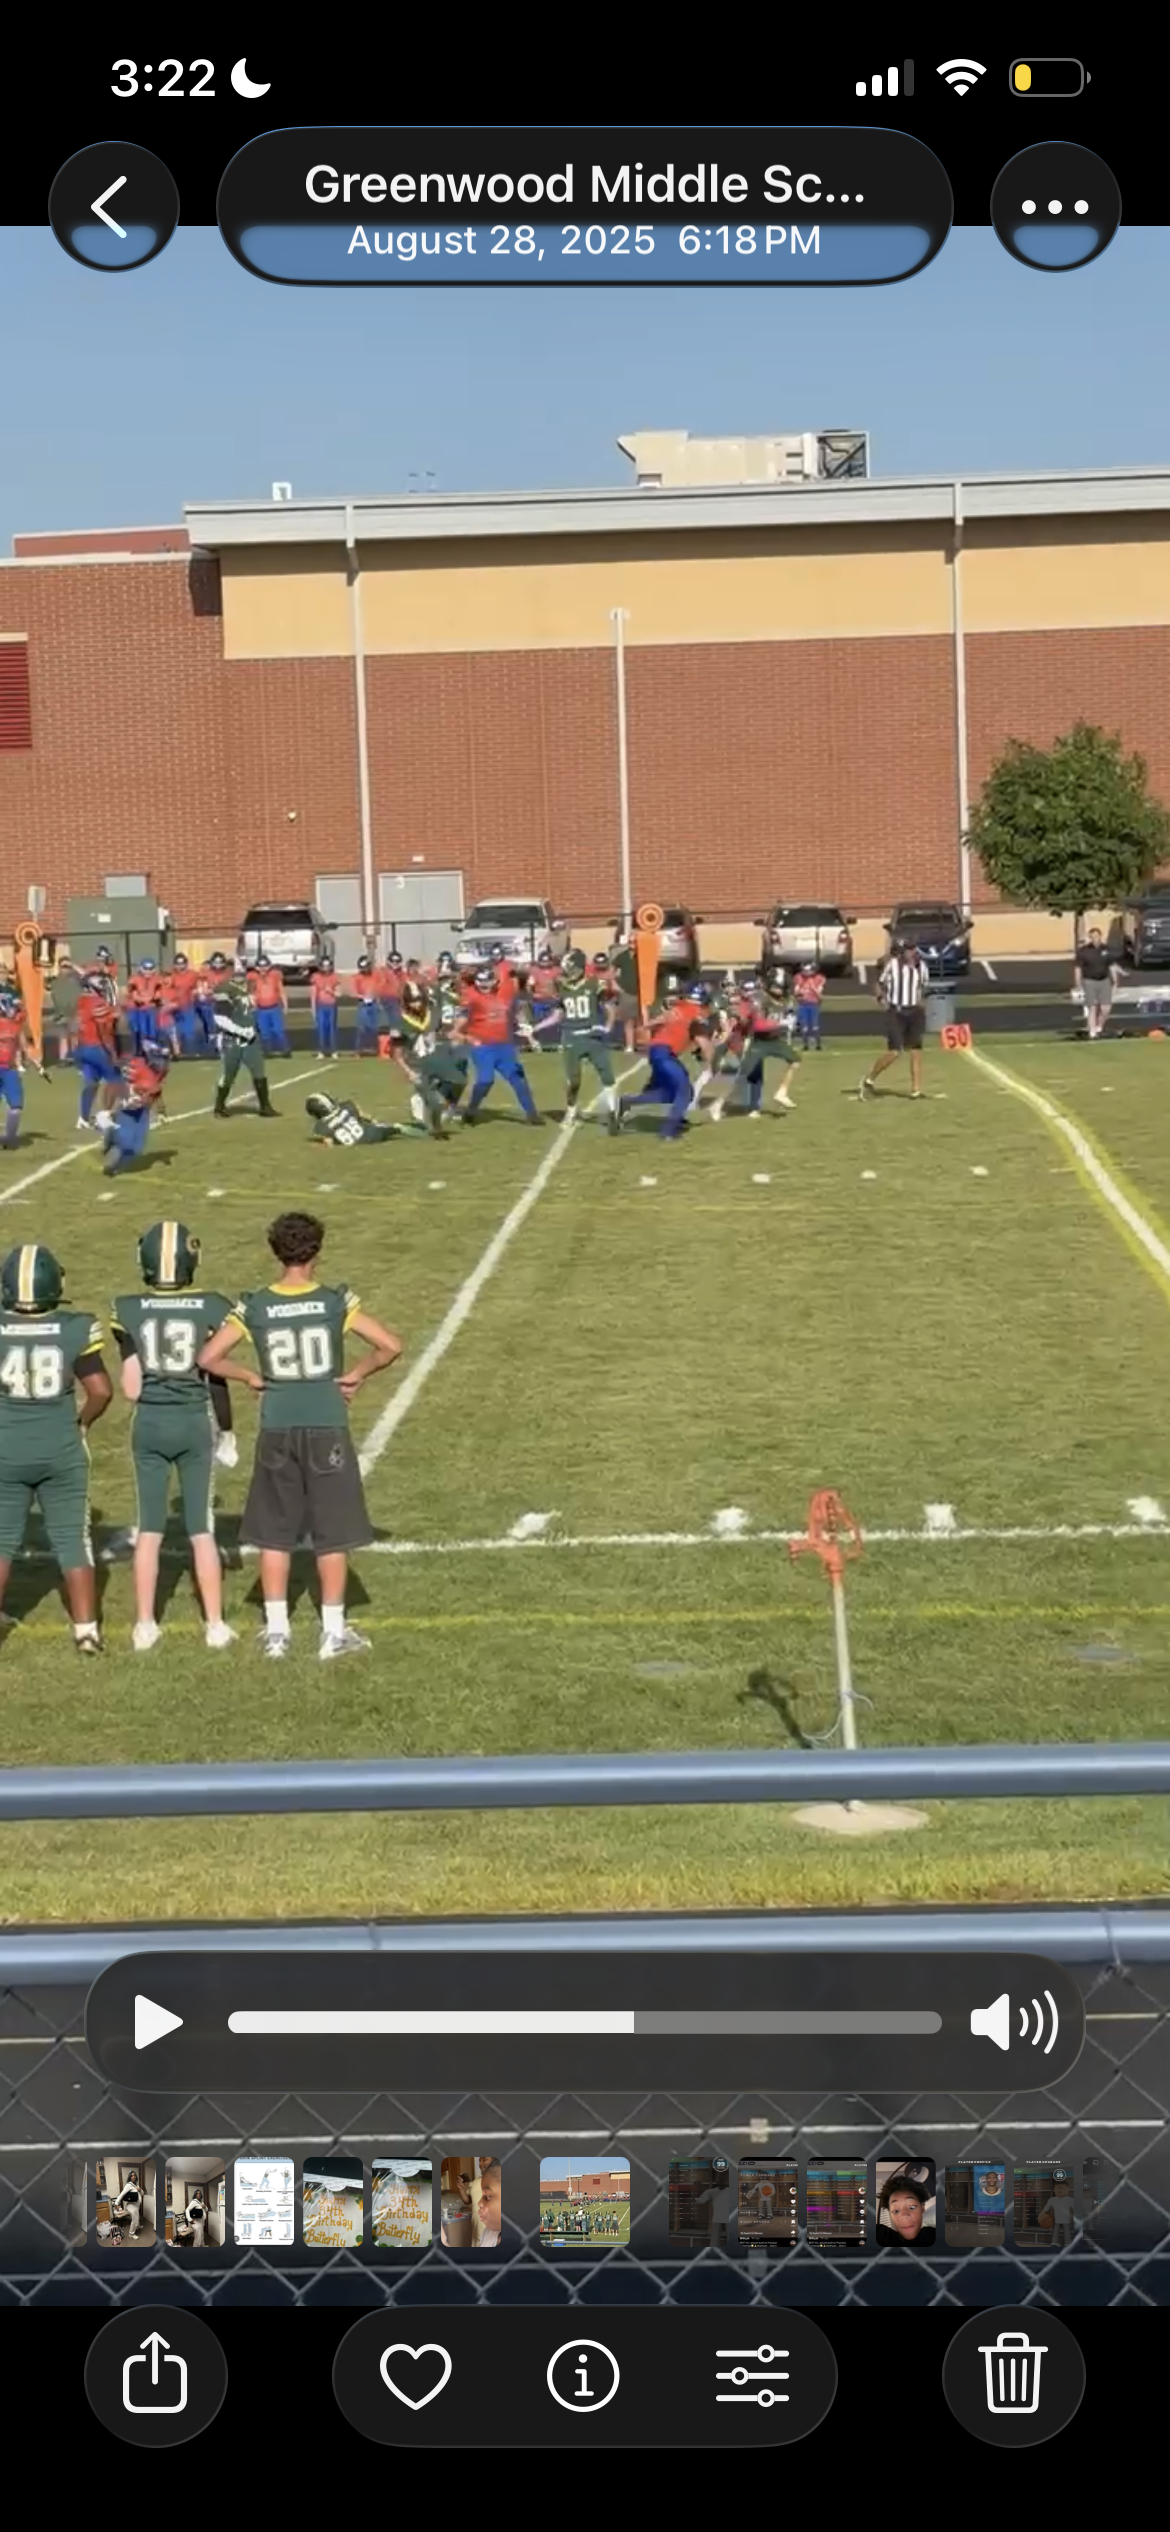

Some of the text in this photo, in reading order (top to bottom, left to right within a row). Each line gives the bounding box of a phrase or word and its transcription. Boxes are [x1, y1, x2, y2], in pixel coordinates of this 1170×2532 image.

[945, 1026, 968, 1049] 50
[140, 1317, 197, 1371] 13
[266, 1325, 332, 1379] 20
[0, 1344, 64, 1398] 48
[318, 2206, 345, 2218] 34th
[388, 2196, 419, 2208] 34th
[305, 2214, 353, 2231] Birthday
[375, 2206, 429, 2223] Birthday
[304, 2229, 347, 2247] Butterfly
[377, 2221, 421, 2245] Butterfly
